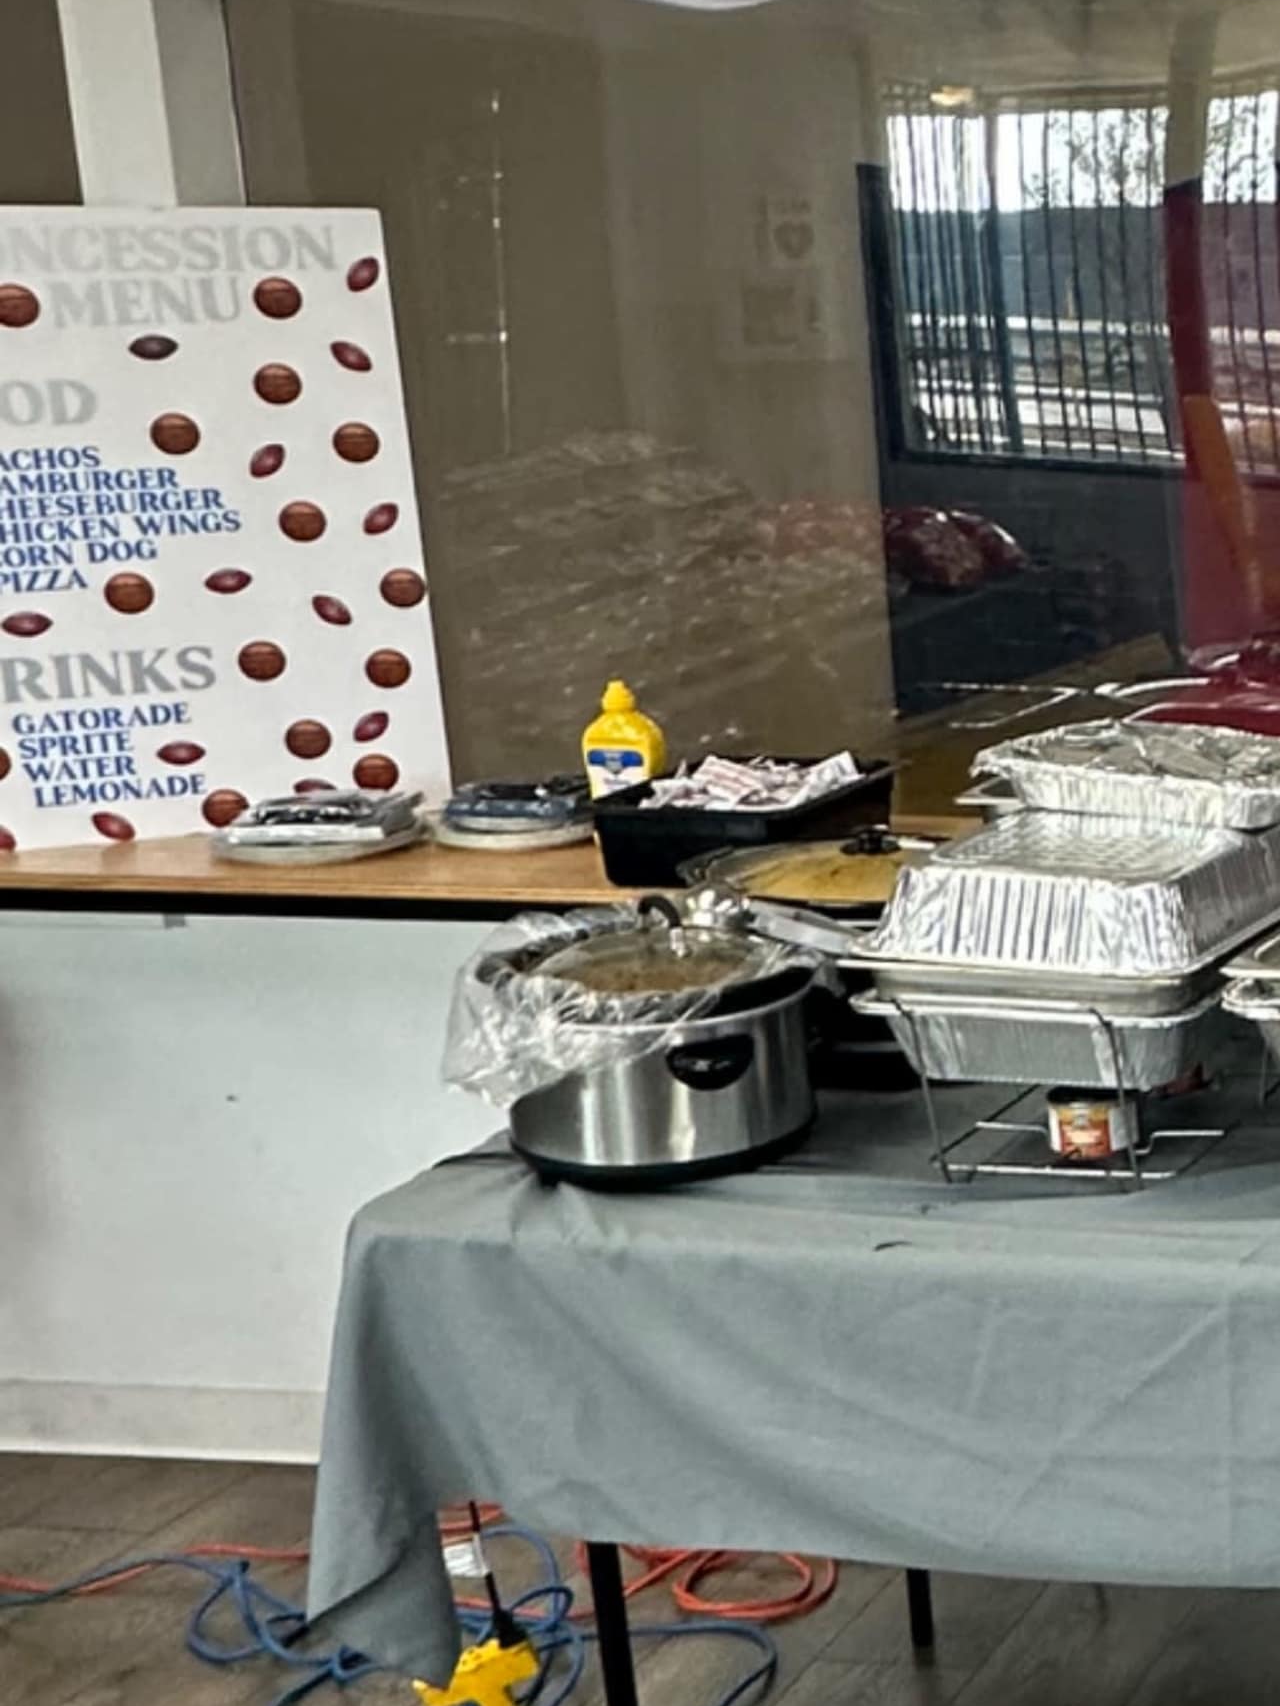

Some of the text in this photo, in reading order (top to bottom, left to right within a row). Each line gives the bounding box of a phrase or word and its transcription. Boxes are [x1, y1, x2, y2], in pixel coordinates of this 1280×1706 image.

[0, 225, 339, 274] NCESSION
[48, 275, 241, 329] MENU
[0, 467, 179, 495] AMBURGER
[133, 510, 242, 536] WINGS
[0, 538, 158, 569] ORN DOG
[0, 646, 217, 704] RINKS
[12, 702, 191, 735] GATORADE
[18, 731, 135, 760] SPRITE
[22, 755, 136, 783] WATER
[34, 774, 207, 809] LEMONADE
